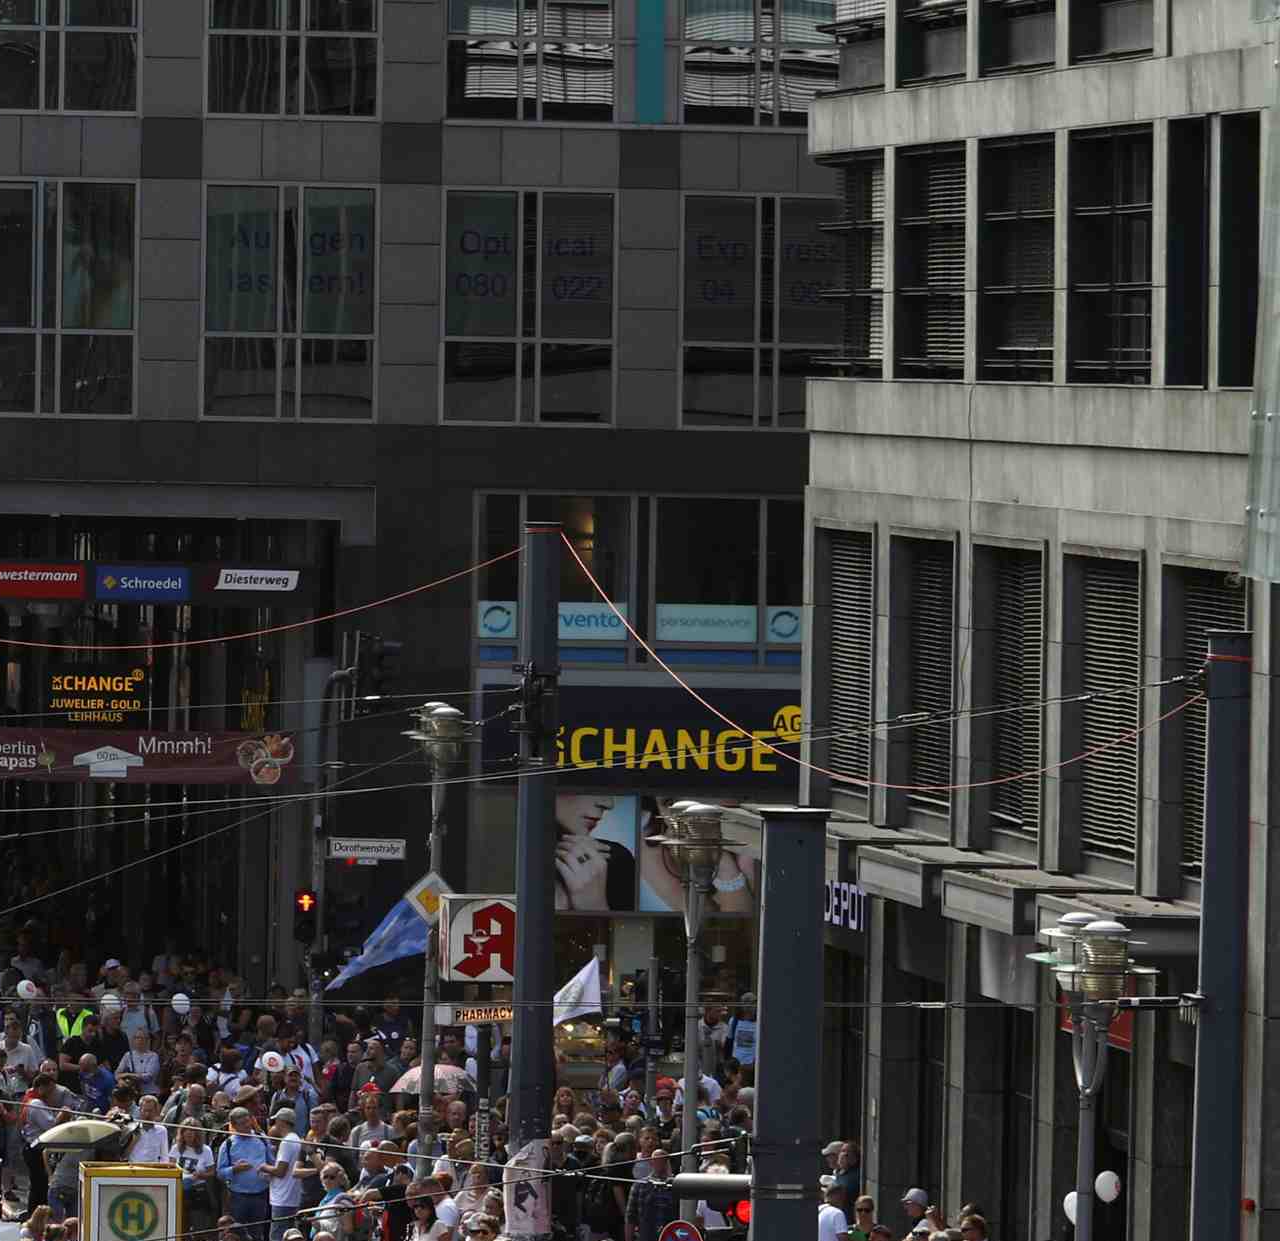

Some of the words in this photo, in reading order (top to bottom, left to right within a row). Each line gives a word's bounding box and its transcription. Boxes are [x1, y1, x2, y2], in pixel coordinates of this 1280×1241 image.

[0, 570, 79, 582] westermann
[120, 576, 182, 591] Schroedel
[223, 573, 290, 588] Diesterweg
[49, 698, 104, 710] JUWELIER
[111, 699, 142, 711] GOLD
[67, 711, 123, 723] LEIHHAUS
[138, 736, 212, 755] Mmmh!
[455, 1006, 513, 1022] PHARMACY
